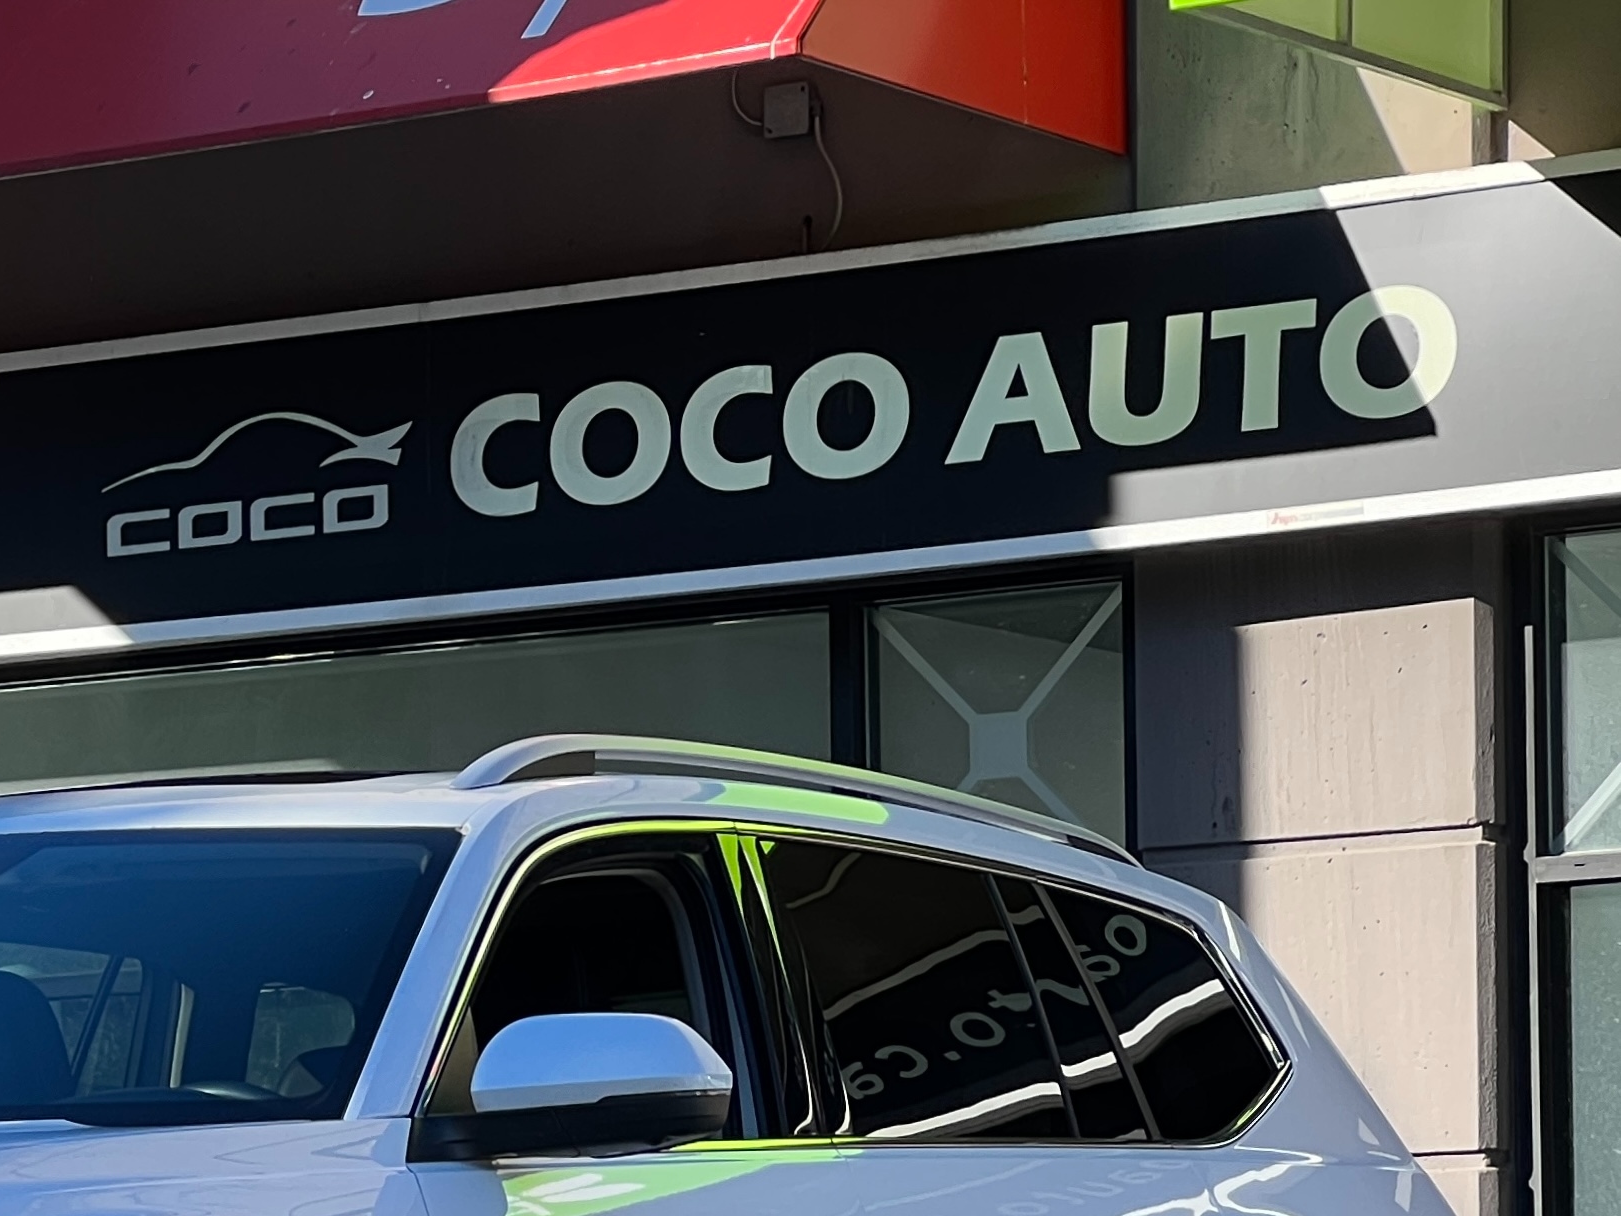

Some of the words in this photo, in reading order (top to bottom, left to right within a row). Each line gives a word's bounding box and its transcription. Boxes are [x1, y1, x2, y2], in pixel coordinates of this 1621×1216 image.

[449, 352, 910, 517] COCO
[945, 285, 1459, 466] AUTO
[106, 483, 389, 557] COCO
